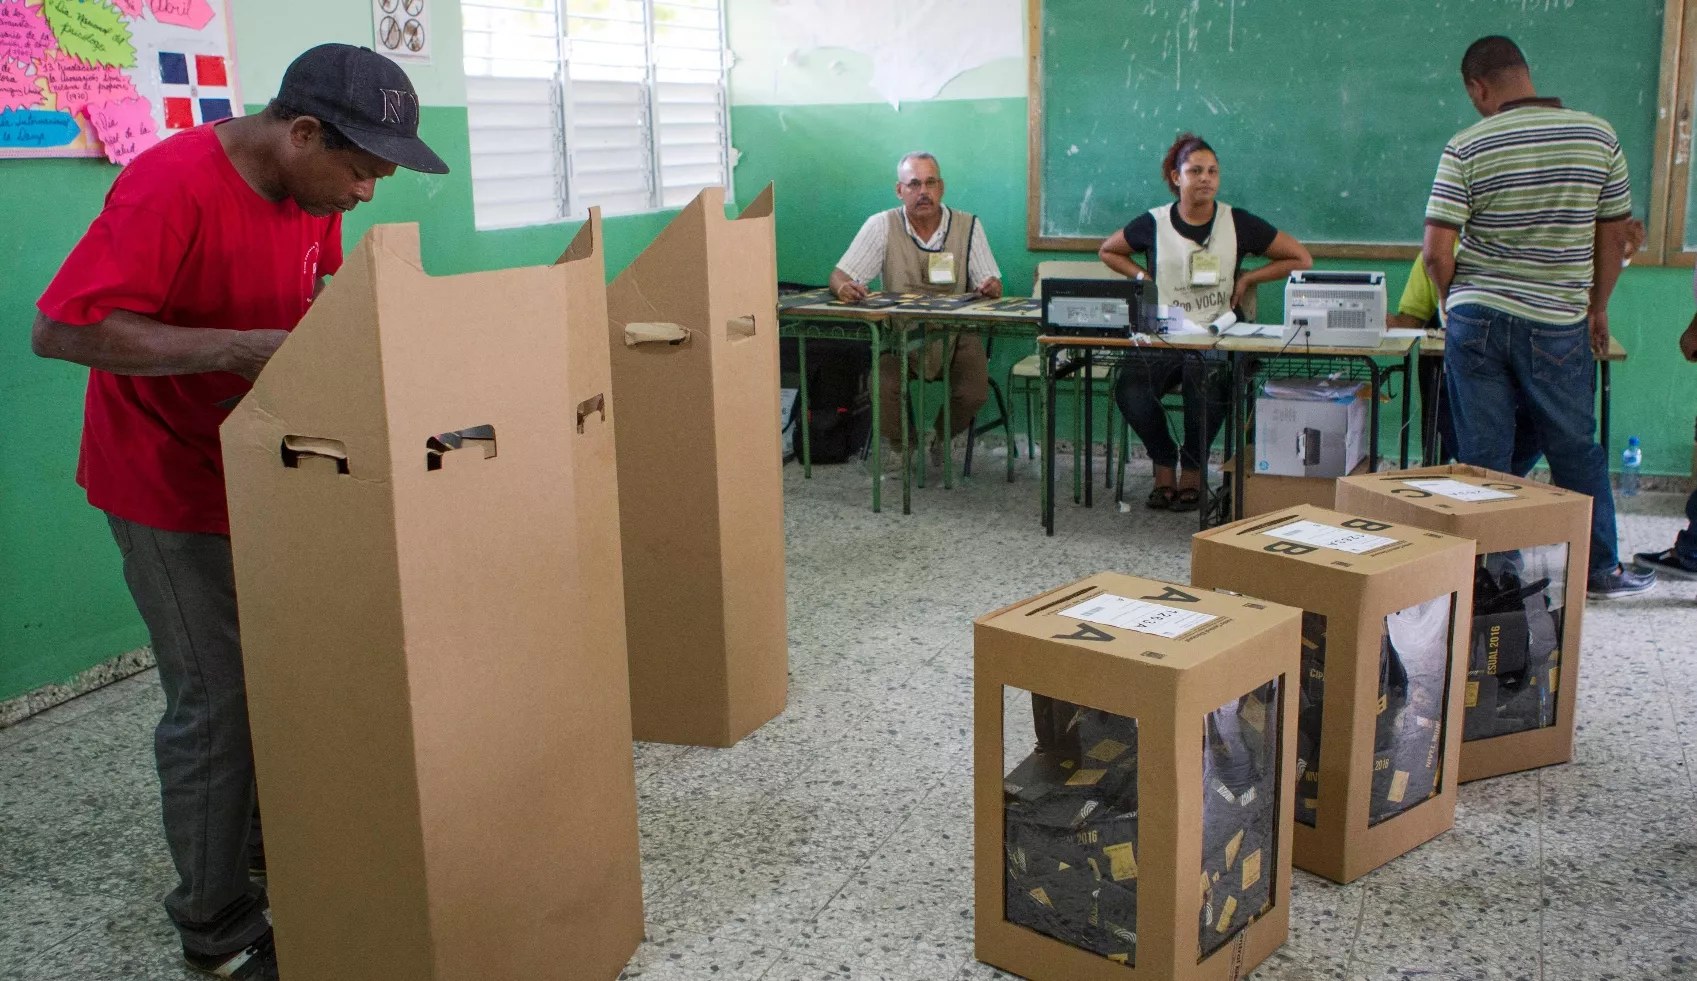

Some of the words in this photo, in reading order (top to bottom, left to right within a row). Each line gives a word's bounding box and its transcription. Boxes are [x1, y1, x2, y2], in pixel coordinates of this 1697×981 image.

[1390, 488, 1434, 498] C
[1482, 482, 1523, 491] C
[1341, 518, 1394, 532] B
[1263, 540, 1319, 556] B
[1140, 586, 1202, 603] A
[1050, 622, 1117, 643] A
[1489, 625, 1501, 648] 2016
[1077, 829, 1098, 846] 2016
